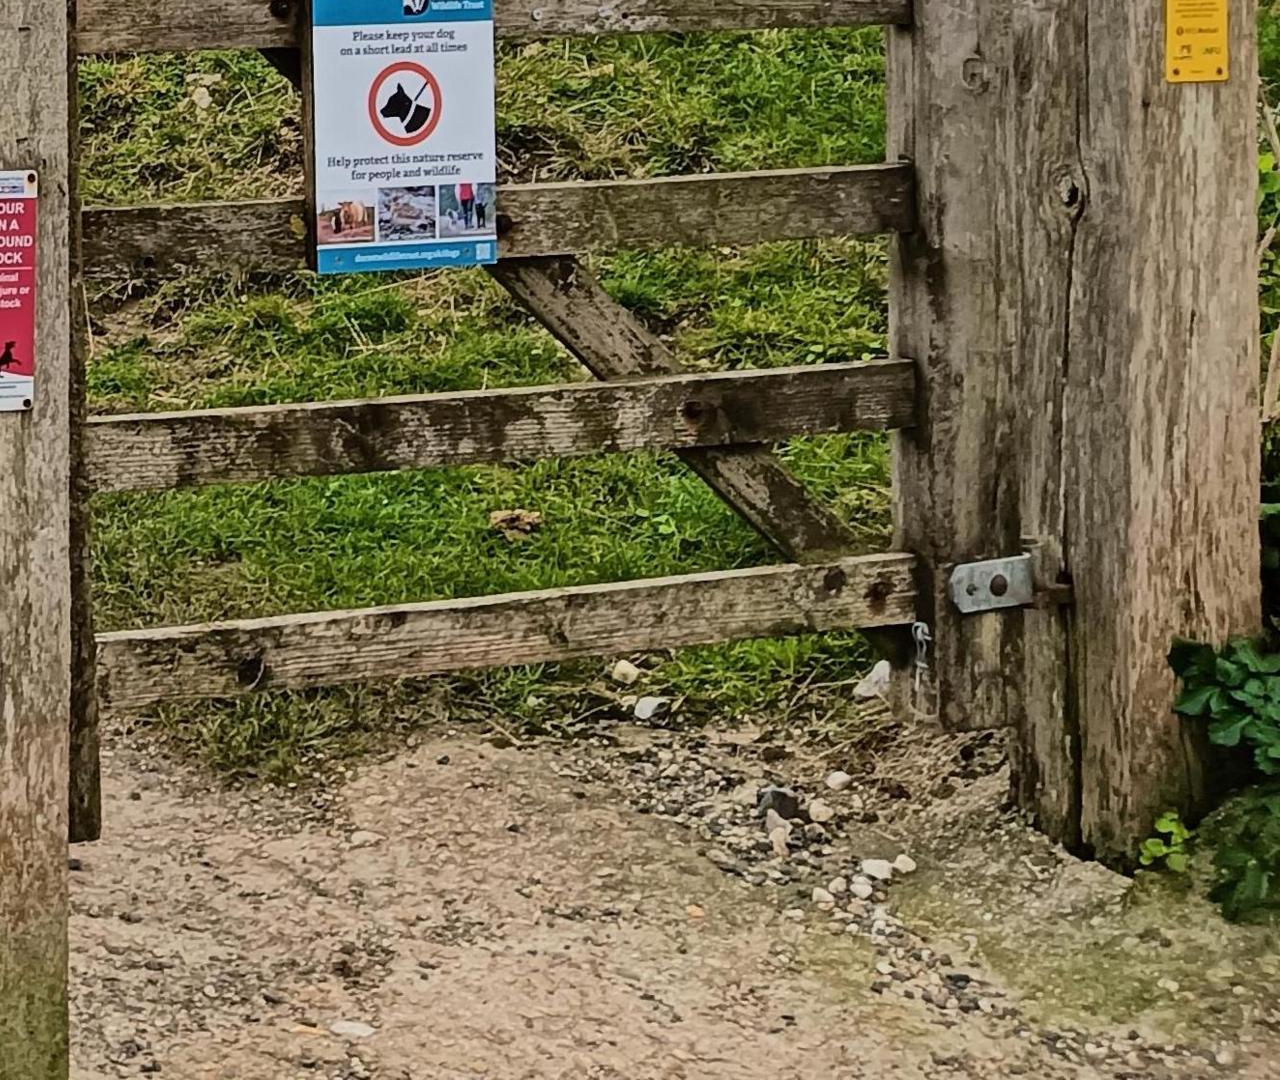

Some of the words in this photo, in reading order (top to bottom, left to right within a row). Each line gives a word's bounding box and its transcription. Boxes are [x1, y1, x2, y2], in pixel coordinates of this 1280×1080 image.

[352, 30, 384, 41] Please
[386, 29, 410, 42] keep
[411, 30, 436, 41] your
[437, 28, 456, 40] dog
[340, 47, 353, 56] on
[354, 47, 361, 56] a
[362, 44, 390, 56] short
[391, 43, 412, 54] lead
[414, 44, 425, 53] at
[426, 42, 439, 53] all
[440, 41, 468, 52] times
[327, 156, 351, 168] Help
[353, 155, 389, 168] protect
[391, 153, 411, 164] this
[412, 153, 445, 163] nature
[447, 152, 484, 161] reserve
[351, 170, 366, 181] for
[368, 168, 401, 181] people
[403, 167, 421, 178] and
[423, 165, 462, 176] wildlife
[9, 219, 20, 230] A
[19, 286, 31, 295] or
